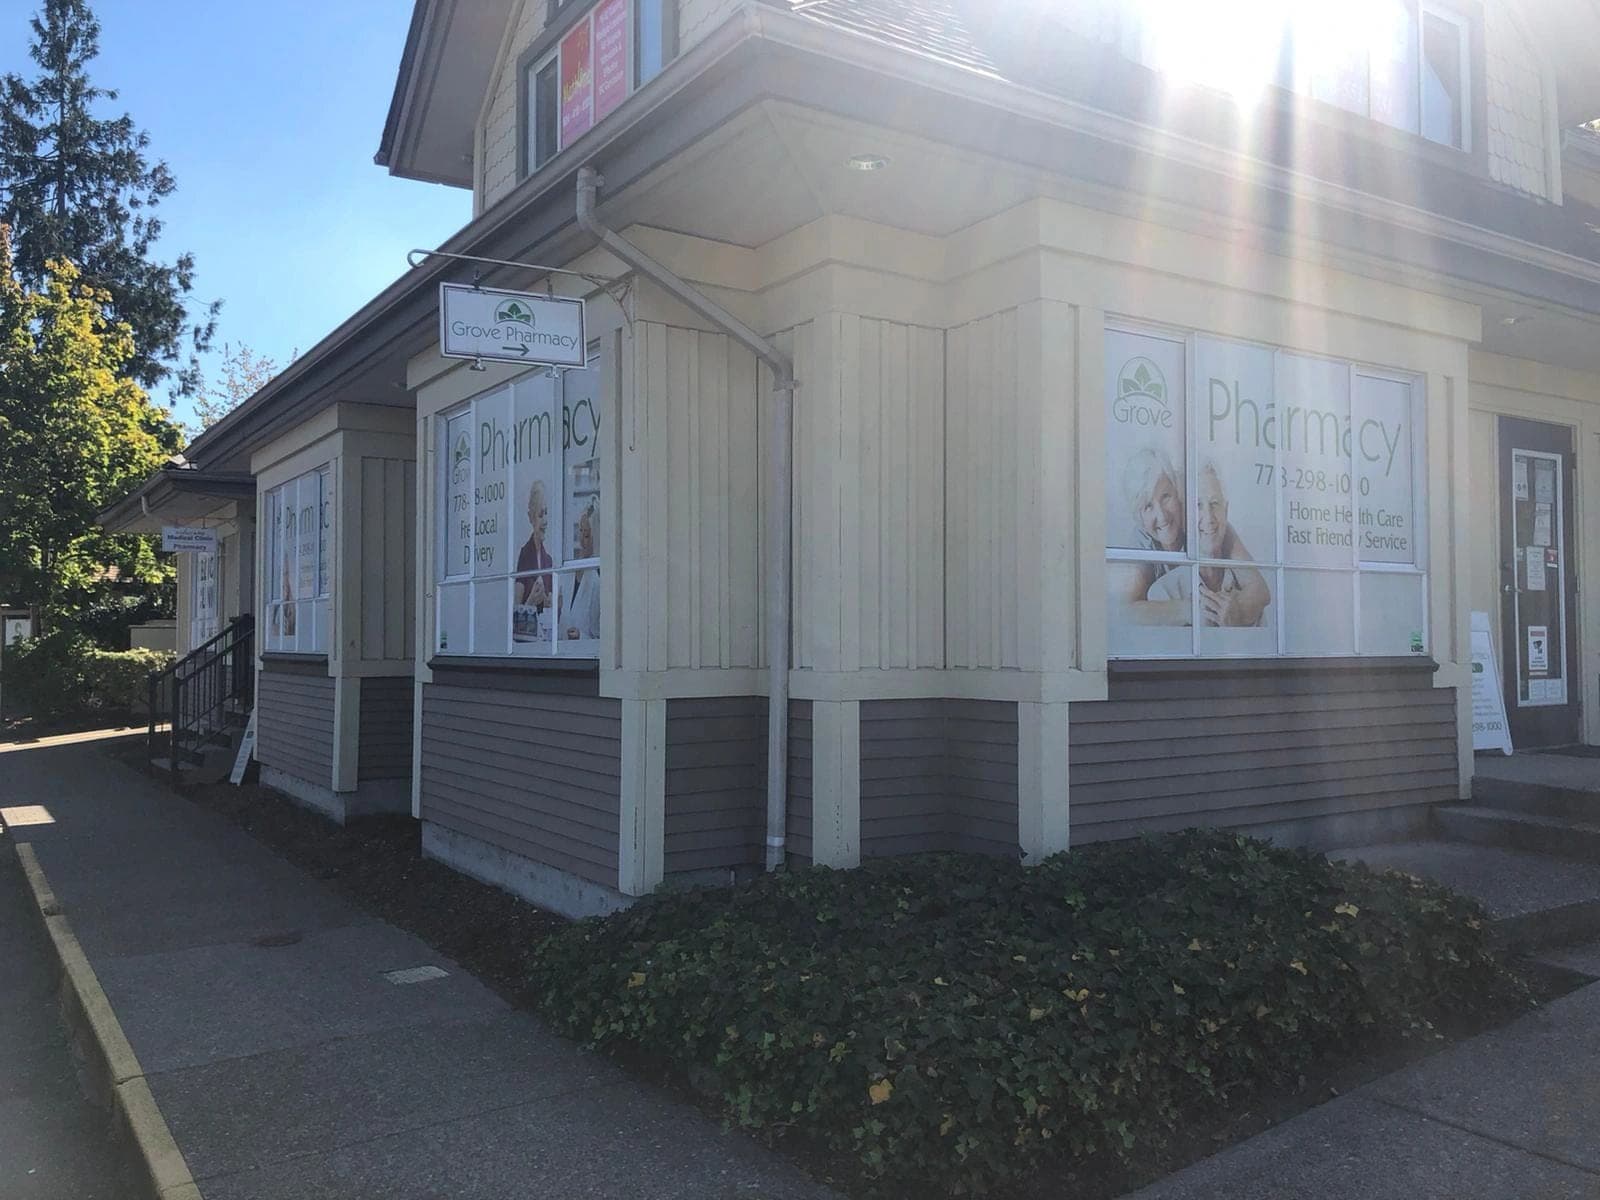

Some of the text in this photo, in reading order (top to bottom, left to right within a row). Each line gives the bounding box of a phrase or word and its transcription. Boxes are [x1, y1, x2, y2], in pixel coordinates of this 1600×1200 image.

[452, 320, 578, 351] Grove Pharmacy
[1112, 396, 1173, 428] Grove
[1208, 377, 1401, 478] Pharmacy
[1254, 462, 1370, 497] 778-298-100
[453, 481, 505, 513] 778-8-1000
[460, 511, 498, 539] Fre Local
[1289, 500, 1404, 528] Home Helth Care
[1287, 525, 1312, 545] Fast
[1364, 530, 1408, 551] Service
